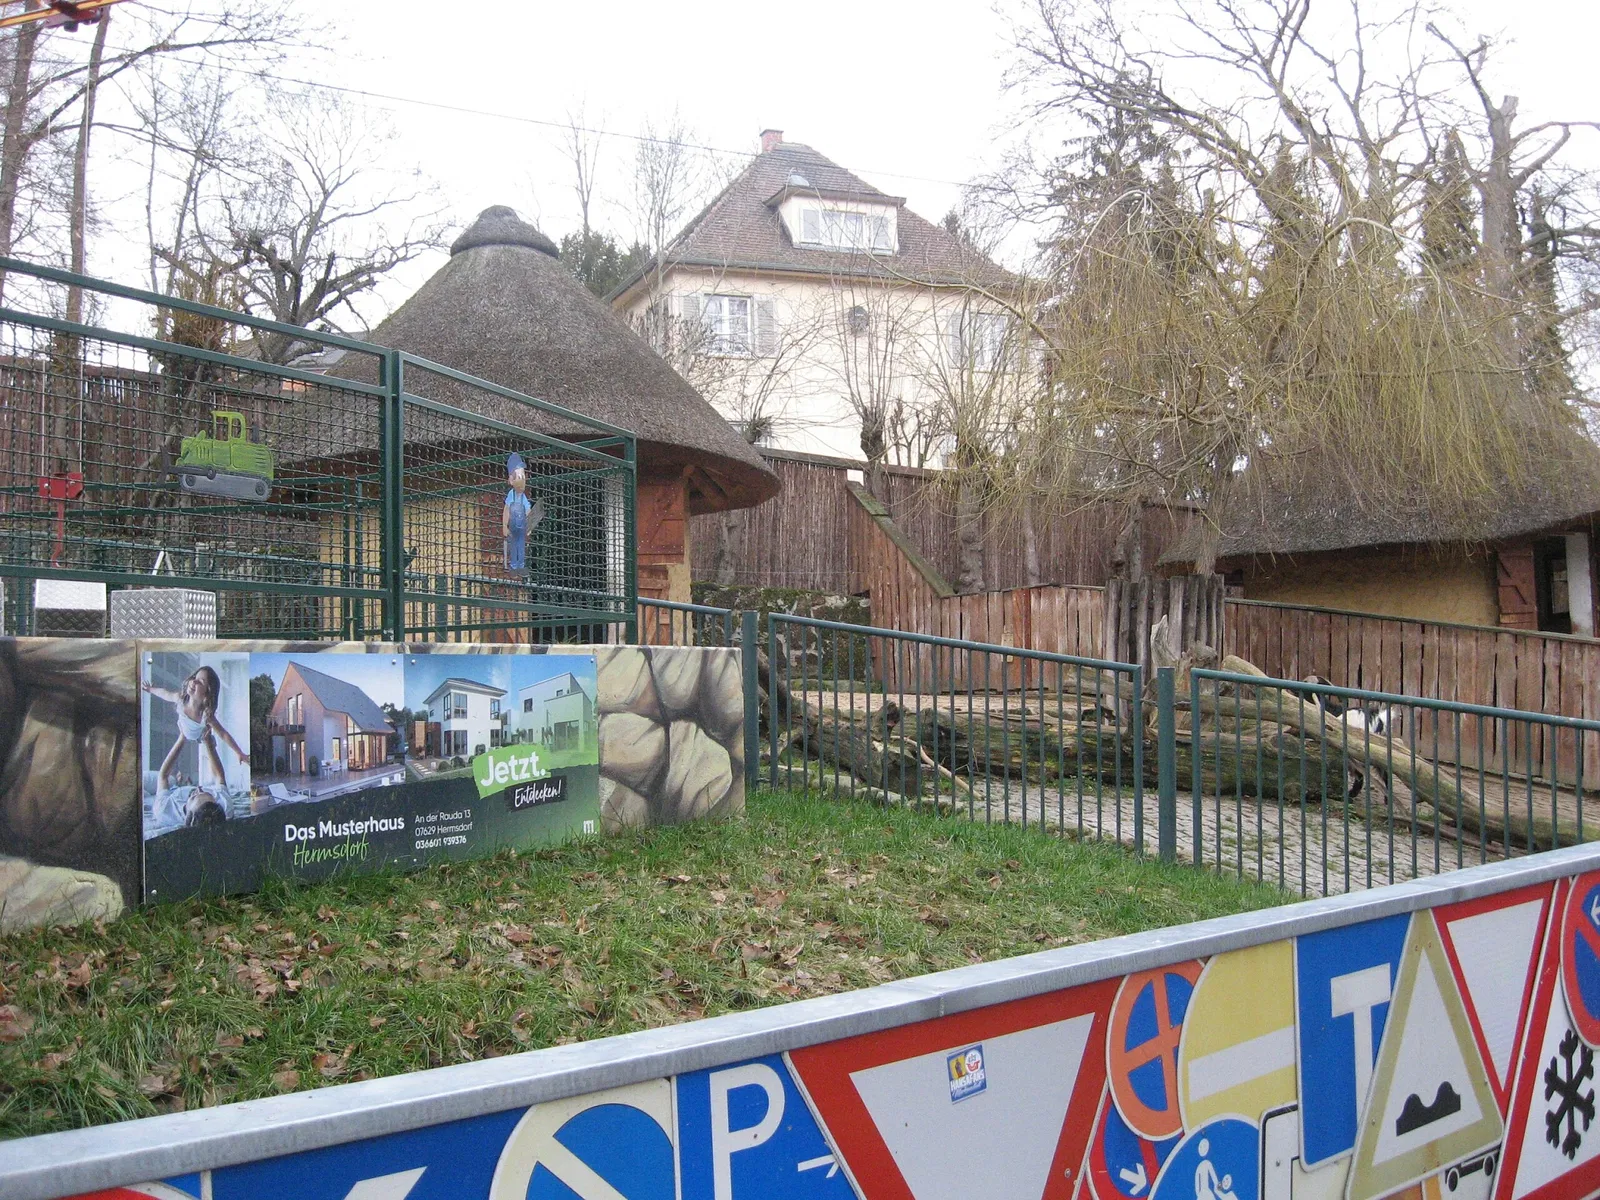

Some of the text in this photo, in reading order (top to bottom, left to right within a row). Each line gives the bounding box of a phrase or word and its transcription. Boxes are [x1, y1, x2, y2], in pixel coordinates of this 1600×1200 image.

[481, 751, 546, 787] Jetzt.
[514, 779, 562, 808] Entdecken!
[285, 816, 405, 842] Das Musterhaus
[414, 809, 471, 824] An der Rauda 13
[414, 821, 473, 837] 07629 Hermsdorf
[293, 831, 370, 869] Hermsdorf
[415, 834, 467, 850] 036601 939376
[709, 1063, 786, 1200] P
